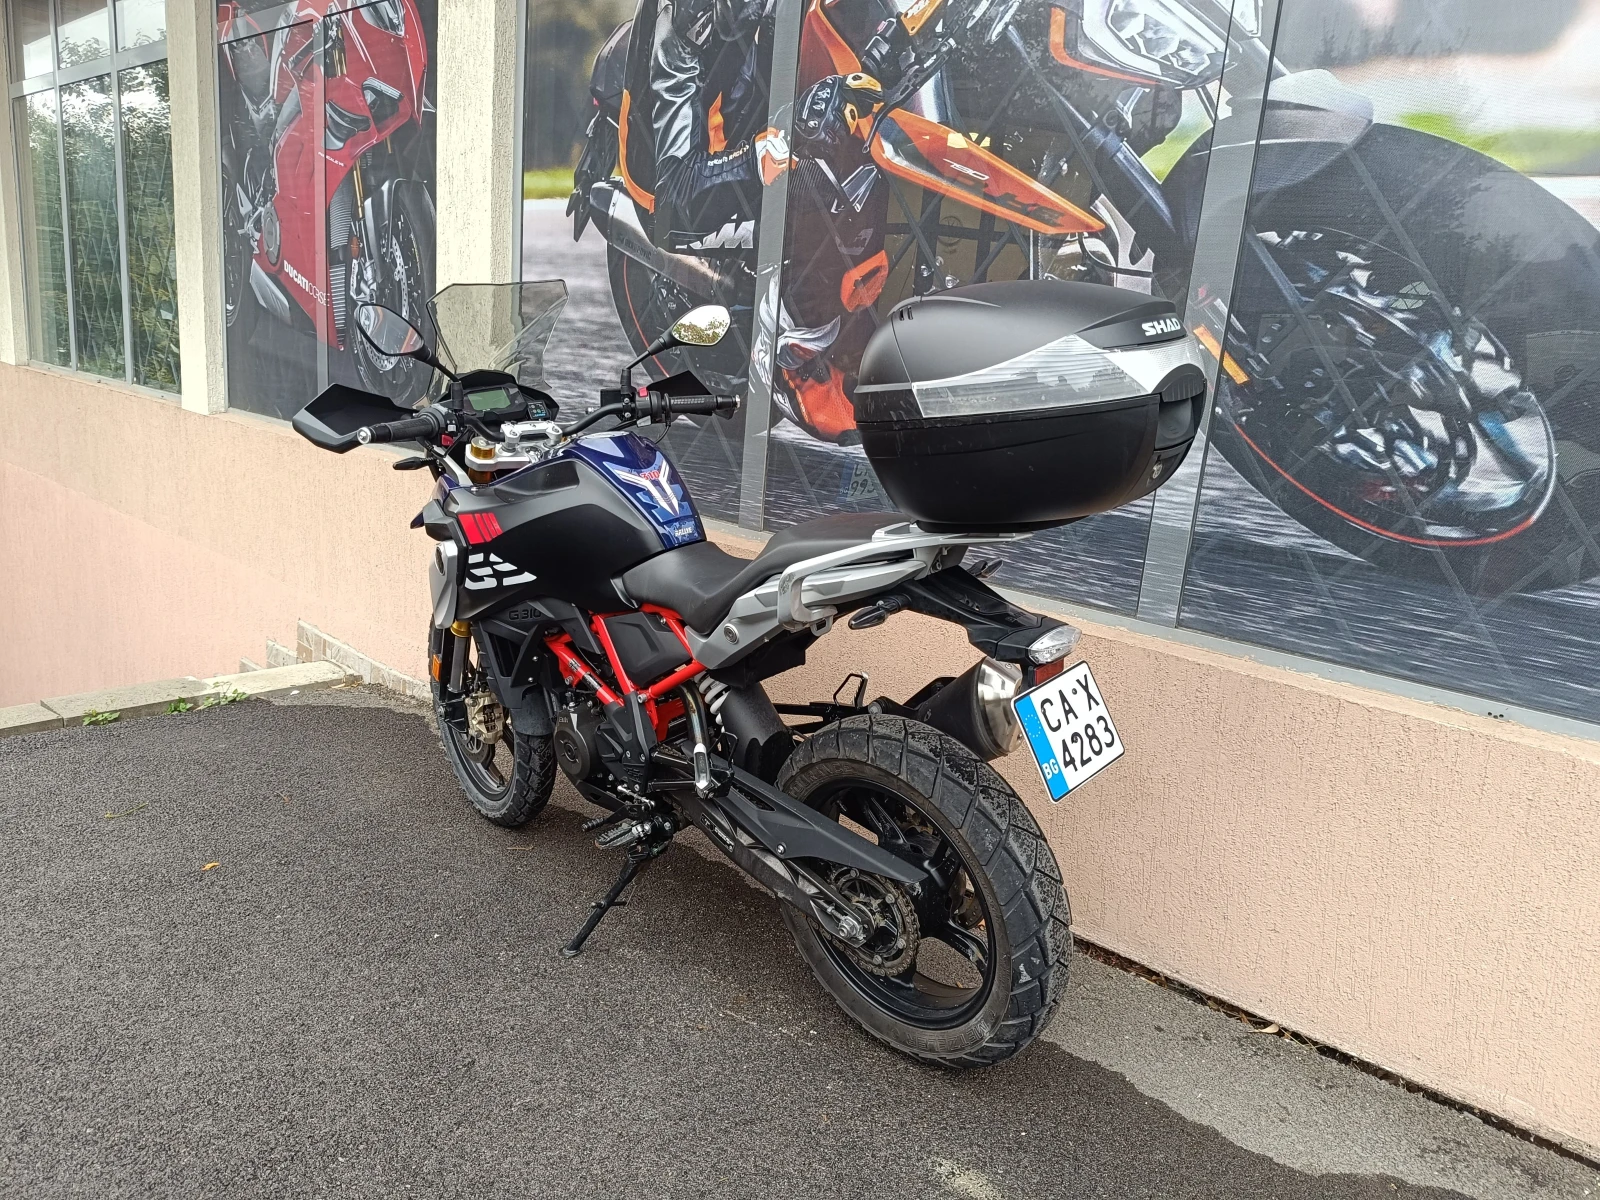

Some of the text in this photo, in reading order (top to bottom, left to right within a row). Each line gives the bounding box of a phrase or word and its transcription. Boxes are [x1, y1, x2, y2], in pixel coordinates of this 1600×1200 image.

[283, 259, 309, 293] DUCATI
[1141, 317, 1181, 336] SHAD
[641, 470, 660, 481] 310
[508, 608, 542, 621] G 310
[1040, 673, 1100, 732] CA X
[1061, 715, 1115, 772] 4283
[1041, 758, 1059, 780] BG
